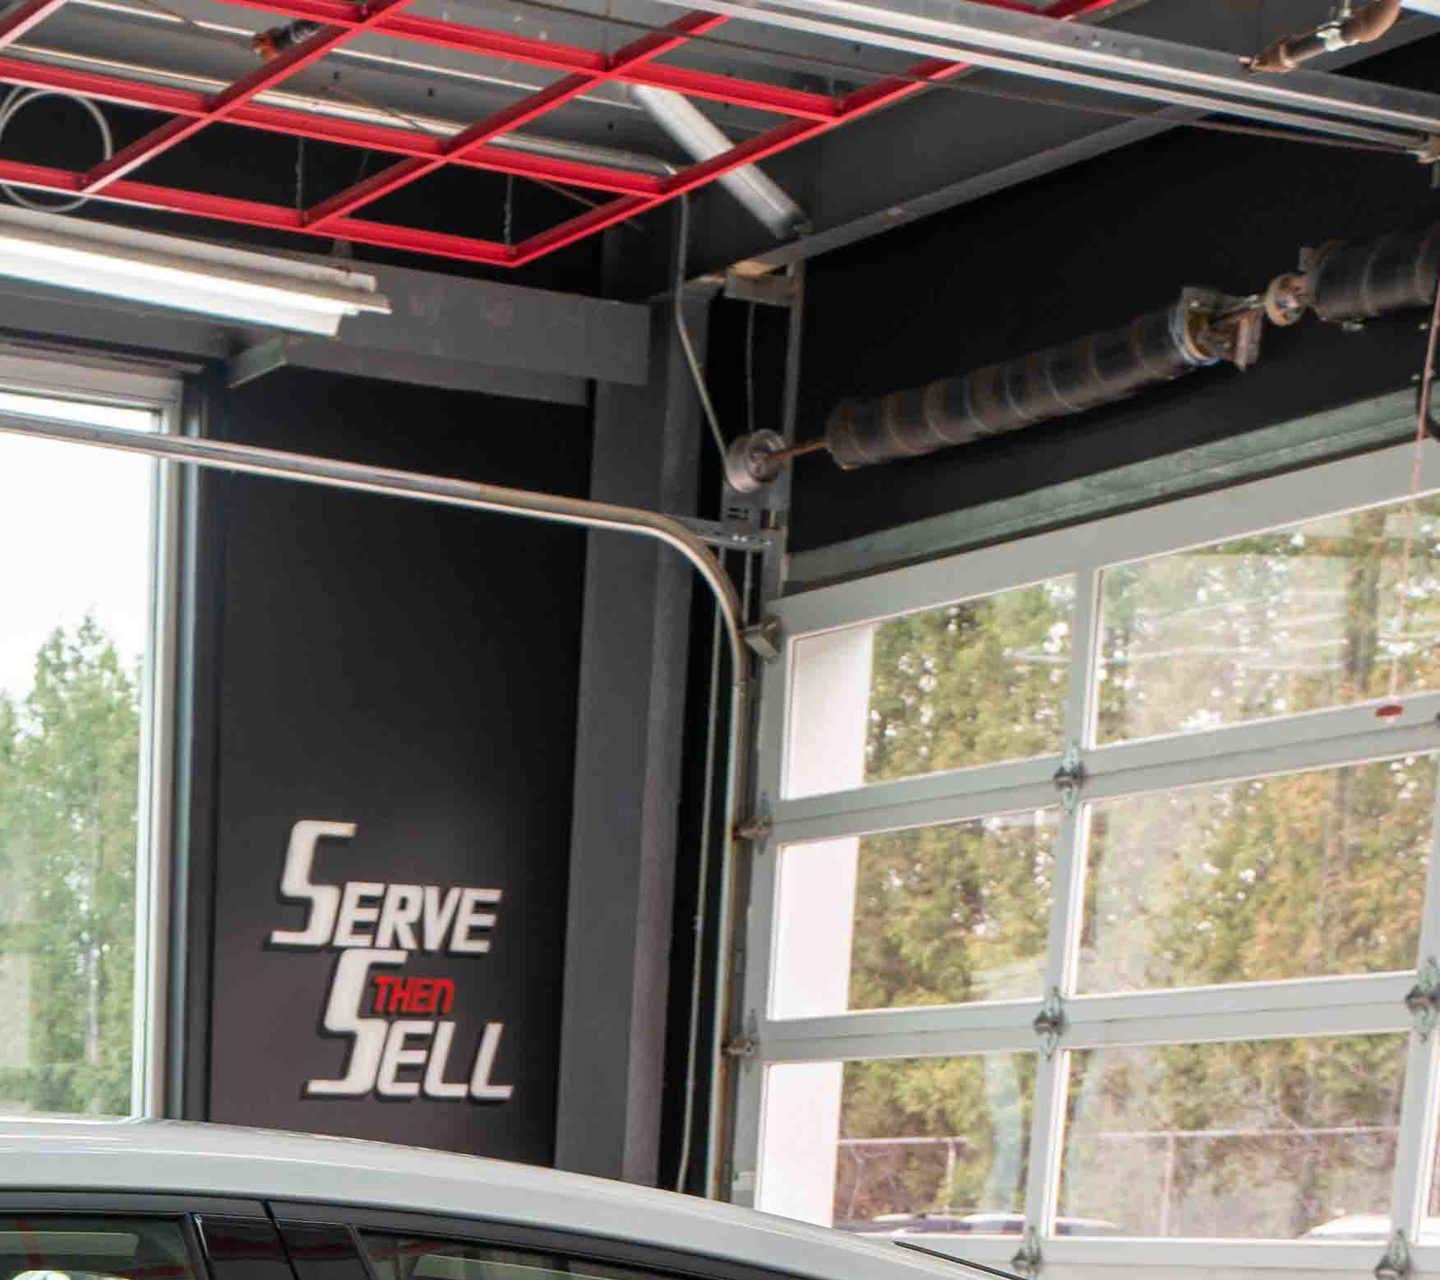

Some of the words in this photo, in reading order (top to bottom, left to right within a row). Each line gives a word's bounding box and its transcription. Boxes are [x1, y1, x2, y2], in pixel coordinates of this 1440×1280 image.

[270, 819, 503, 953] SERVE
[306, 948, 514, 1101] SELL
[372, 975, 457, 1014] THEN
